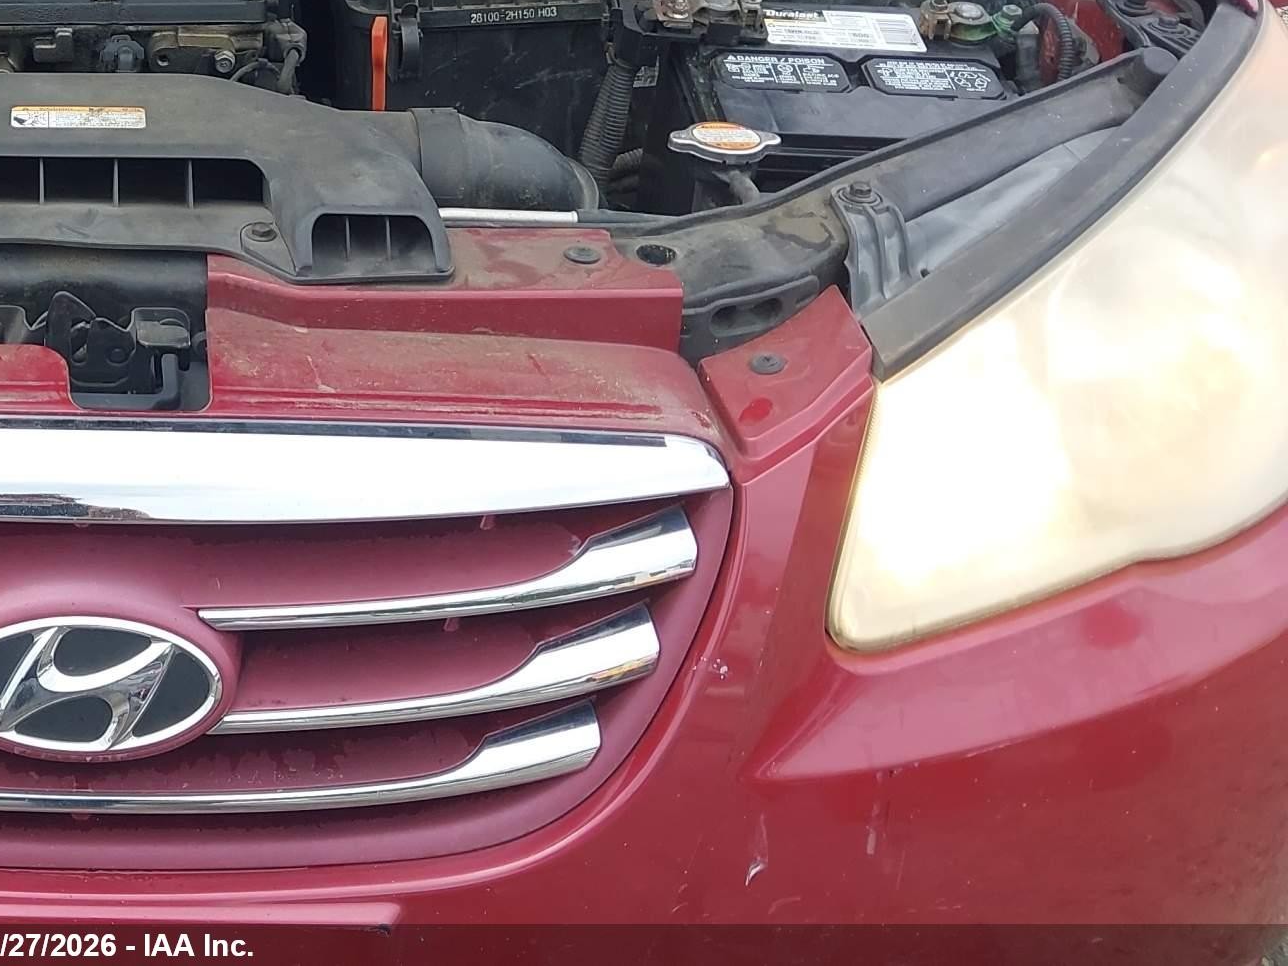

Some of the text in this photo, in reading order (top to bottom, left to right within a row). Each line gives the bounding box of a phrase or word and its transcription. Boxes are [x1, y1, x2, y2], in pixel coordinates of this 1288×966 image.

[470, 6, 557, 24] 28100-2H150 H03
[737, 55, 778, 63] DANGER
[787, 56, 825, 65] POISON
